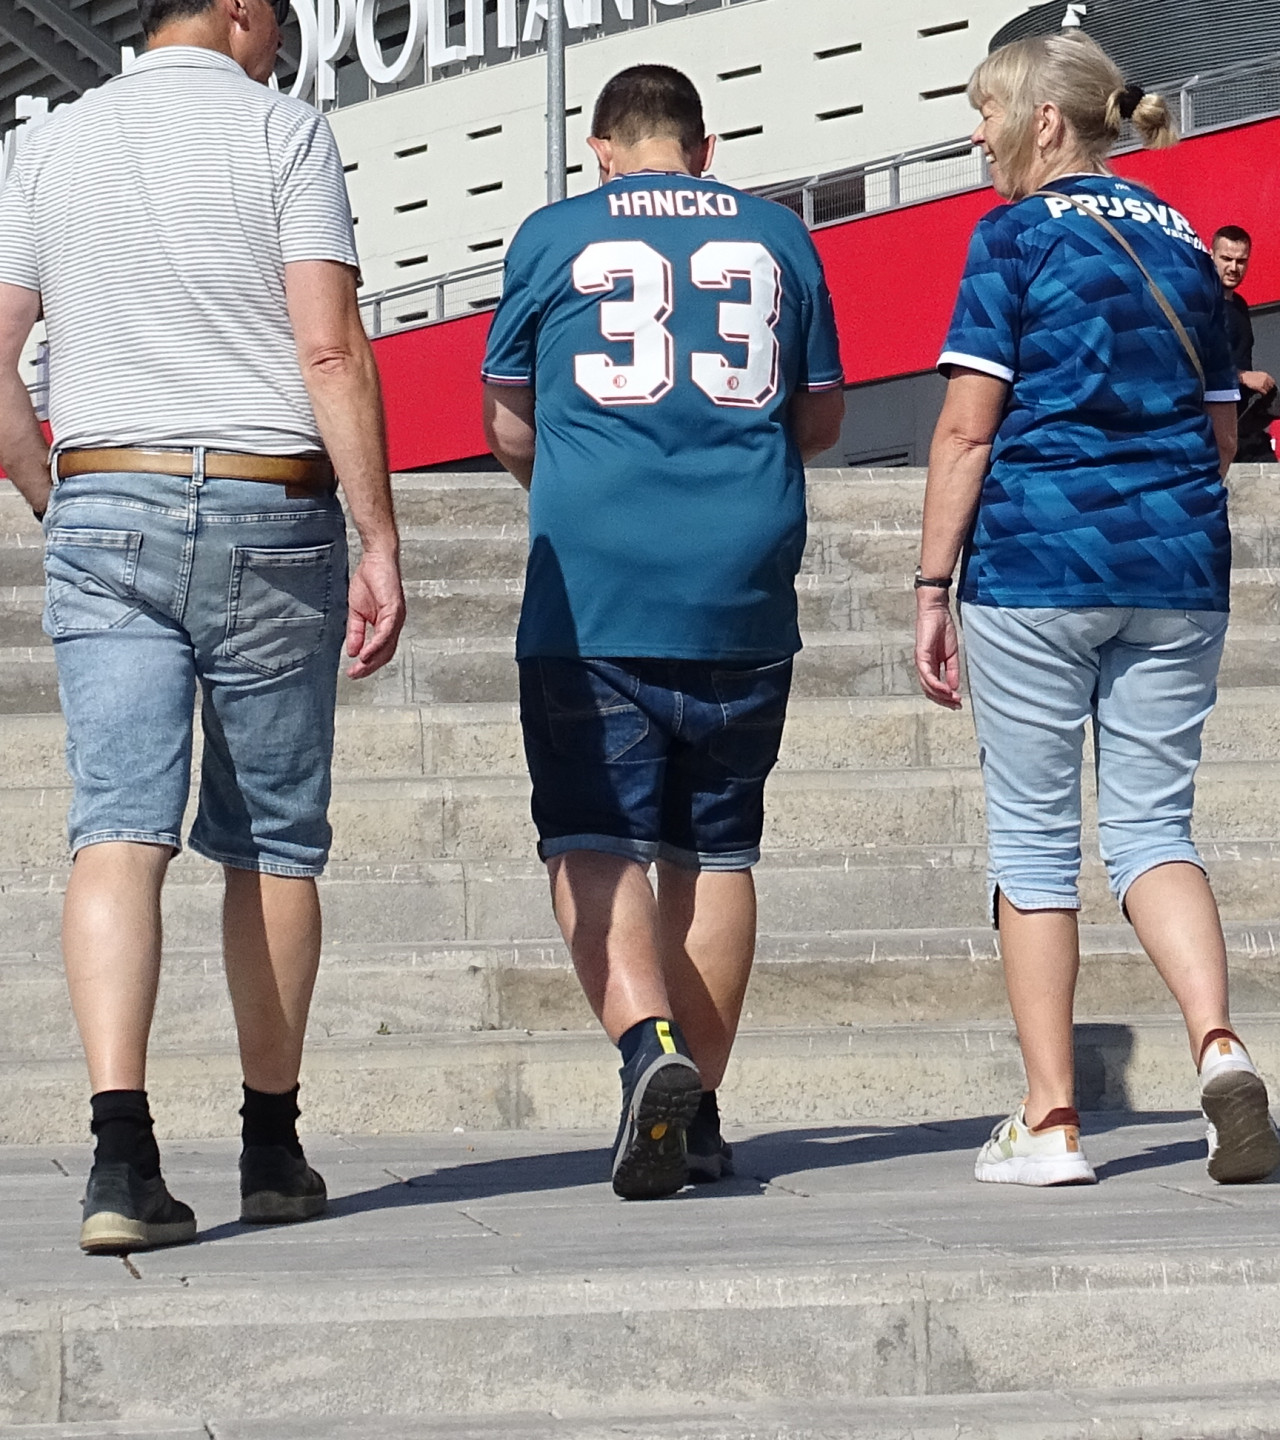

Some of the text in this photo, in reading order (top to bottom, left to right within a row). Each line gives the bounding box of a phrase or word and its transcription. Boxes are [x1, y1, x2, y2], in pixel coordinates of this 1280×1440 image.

[608, 190, 739, 217] HANCKO
[1044, 194, 1197, 235] PRIJSVR
[572, 240, 782, 408] 33
